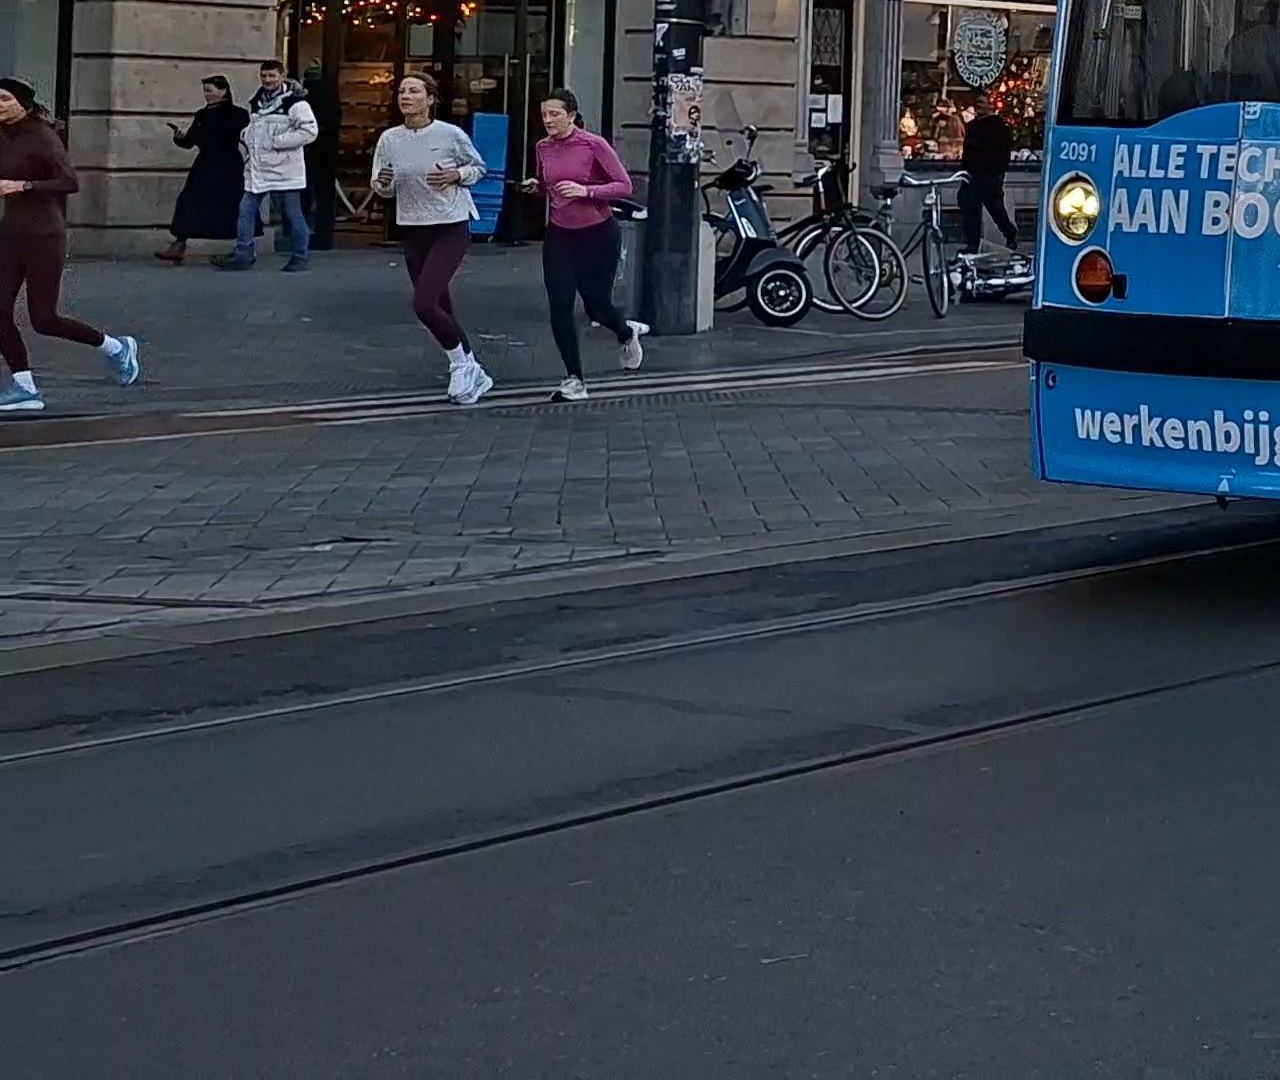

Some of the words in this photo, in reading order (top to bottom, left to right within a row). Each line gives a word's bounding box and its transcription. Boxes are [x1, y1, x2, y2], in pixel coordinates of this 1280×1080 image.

[1060, 141, 1097, 162] 2091
[1114, 143, 1186, 179] ALLE
[1110, 188, 1189, 234] AAN
